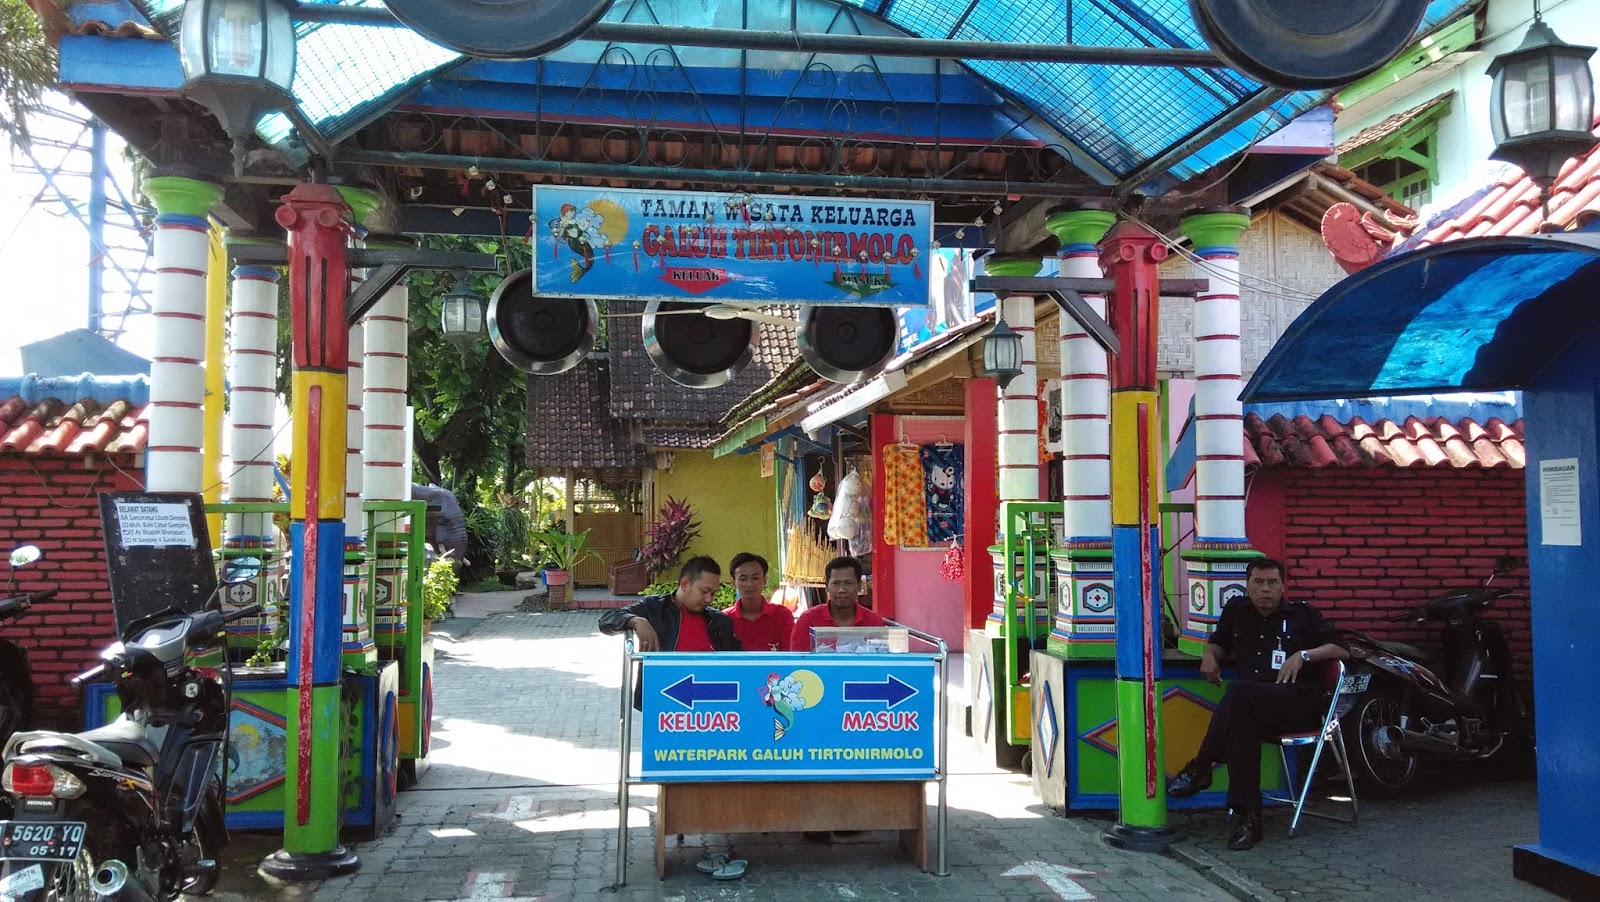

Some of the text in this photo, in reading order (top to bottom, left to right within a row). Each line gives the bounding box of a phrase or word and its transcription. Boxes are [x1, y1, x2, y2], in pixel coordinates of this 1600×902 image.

[641, 199, 715, 219] TAMAN
[811, 205, 916, 227] KELUARGA
[643, 224, 915, 264] GALUH TIRTONIRMOLO
[672, 270, 720, 281] KELUAR
[841, 275, 884, 286] MASUK
[1542, 465, 1576, 473] HIMBAUAN
[119, 505, 158, 513] SELAMAT DATANG
[658, 711, 741, 732] KELUAR
[842, 711, 919, 732] MASUK
[654, 747, 924, 762] WATERPARK GALUH TIRTONIRMOLO
[12, 825, 55, 842] 5620
